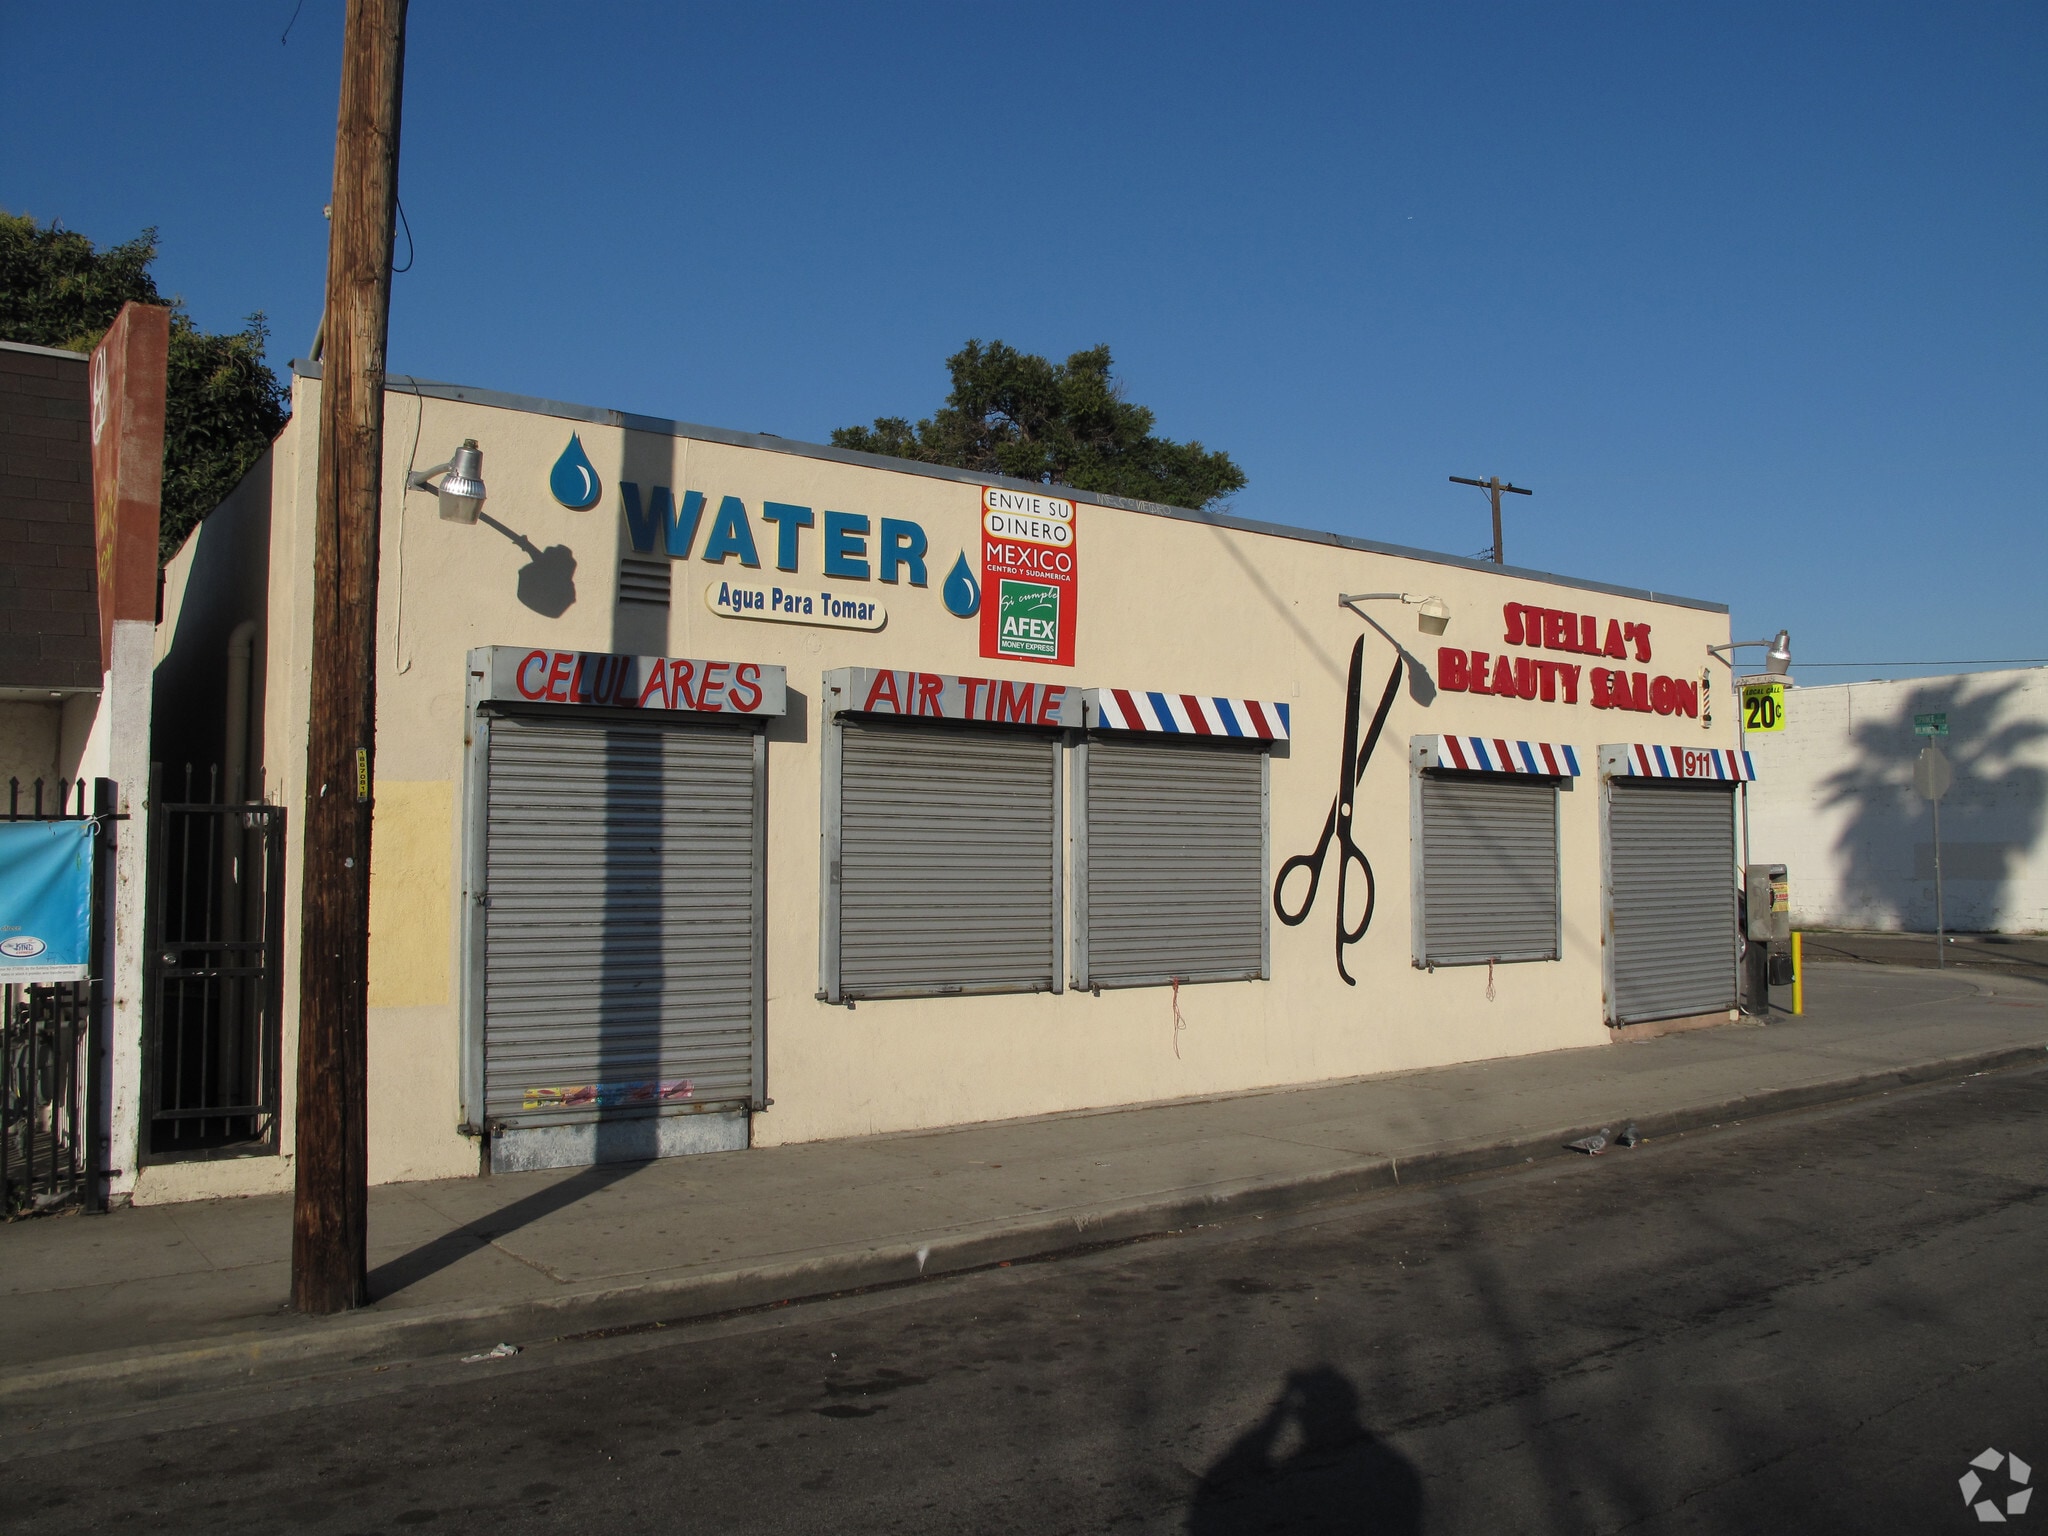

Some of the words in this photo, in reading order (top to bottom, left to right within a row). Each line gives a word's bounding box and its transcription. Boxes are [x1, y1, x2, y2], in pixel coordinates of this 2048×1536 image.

[989, 491, 1041, 514] ENVIE
[1049, 501, 1069, 518] SU
[620, 481, 928, 587] WATER
[991, 515, 1067, 542] DINERO
[986, 541, 1072, 573] MEXICO
[987, 564, 1017, 575] CENTRO
[1025, 569, 1071, 582] SUDAMERICA
[718, 581, 765, 613] Agua
[772, 587, 813, 615] Para
[821, 592, 875, 621] Tomar
[1018, 587, 1059, 604] cumple
[1003, 616, 1055, 640] AFEX
[1503, 601, 1652, 663] STELLA'S
[1002, 640, 1025, 650] MONEY
[1025, 642, 1055, 653] EXPRESS
[515, 650, 764, 713] CELULARES
[1437, 646, 1581, 705] BEAUTY
[1590, 667, 1699, 719] SALON
[863, 669, 944, 718] AIR
[957, 676, 1067, 726] TIME
[1685, 751, 1710, 777] 911
